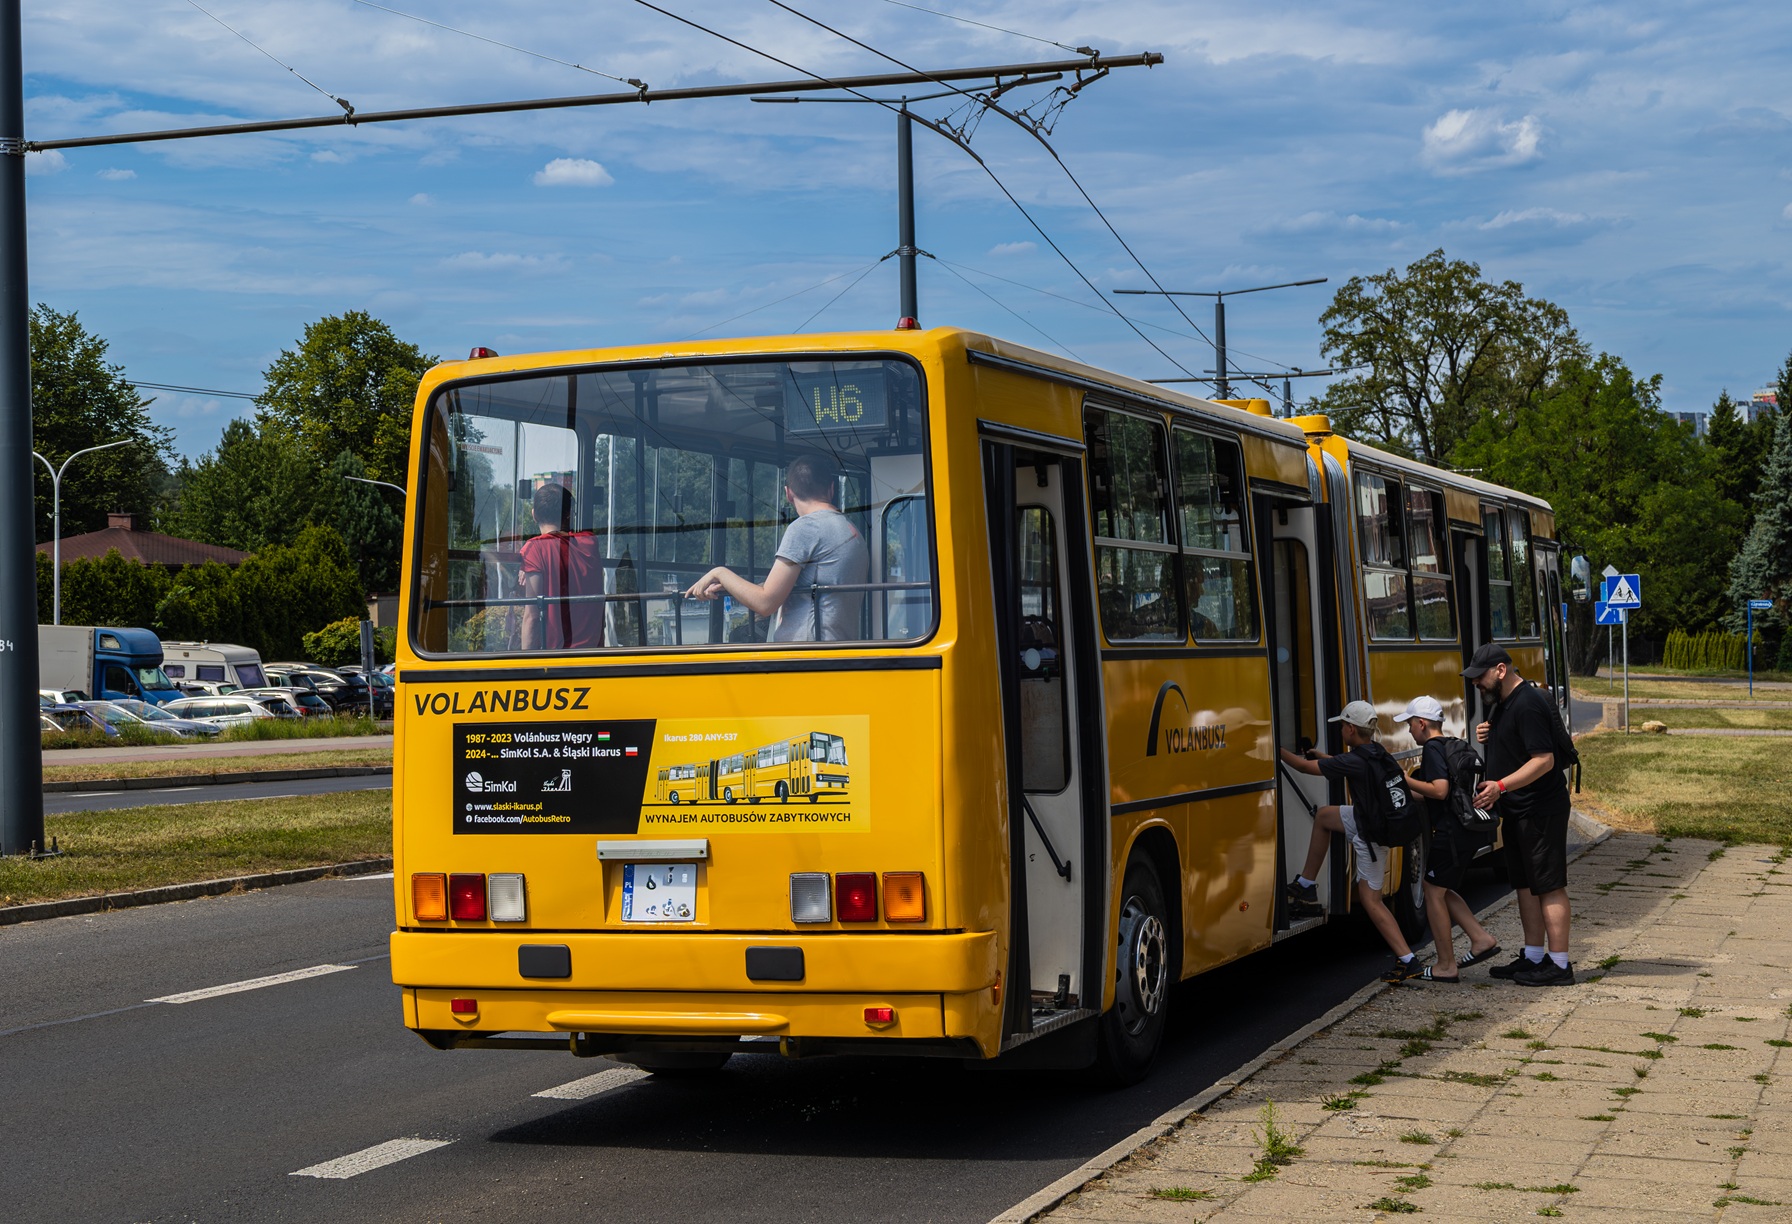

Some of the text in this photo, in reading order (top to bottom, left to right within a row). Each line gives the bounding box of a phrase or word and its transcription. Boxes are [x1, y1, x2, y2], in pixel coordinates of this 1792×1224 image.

[814, 385, 863, 424] W6
[415, 687, 591, 716] VOLÁNBUSZ
[466, 732, 593, 744] 1987-2023 Volánbusz Węgry
[664, 733, 738, 742] Ikarus 280 ANY-537
[500, 748, 532, 758] SimKol
[533, 748, 551, 758] S.A.
[553, 748, 561, 757] &
[562, 745, 590, 760] Śląski
[592, 747, 621, 757] Ikarus
[484, 780, 517, 792] SimKol
[474, 802, 543, 811] www.slaski-ikarus.pl
[474, 814, 571, 824] facebook.com/AutobusRetro
[645, 811, 851, 823] WYNAJEM AUTOBUSÓW ZABYTKOWYCH
